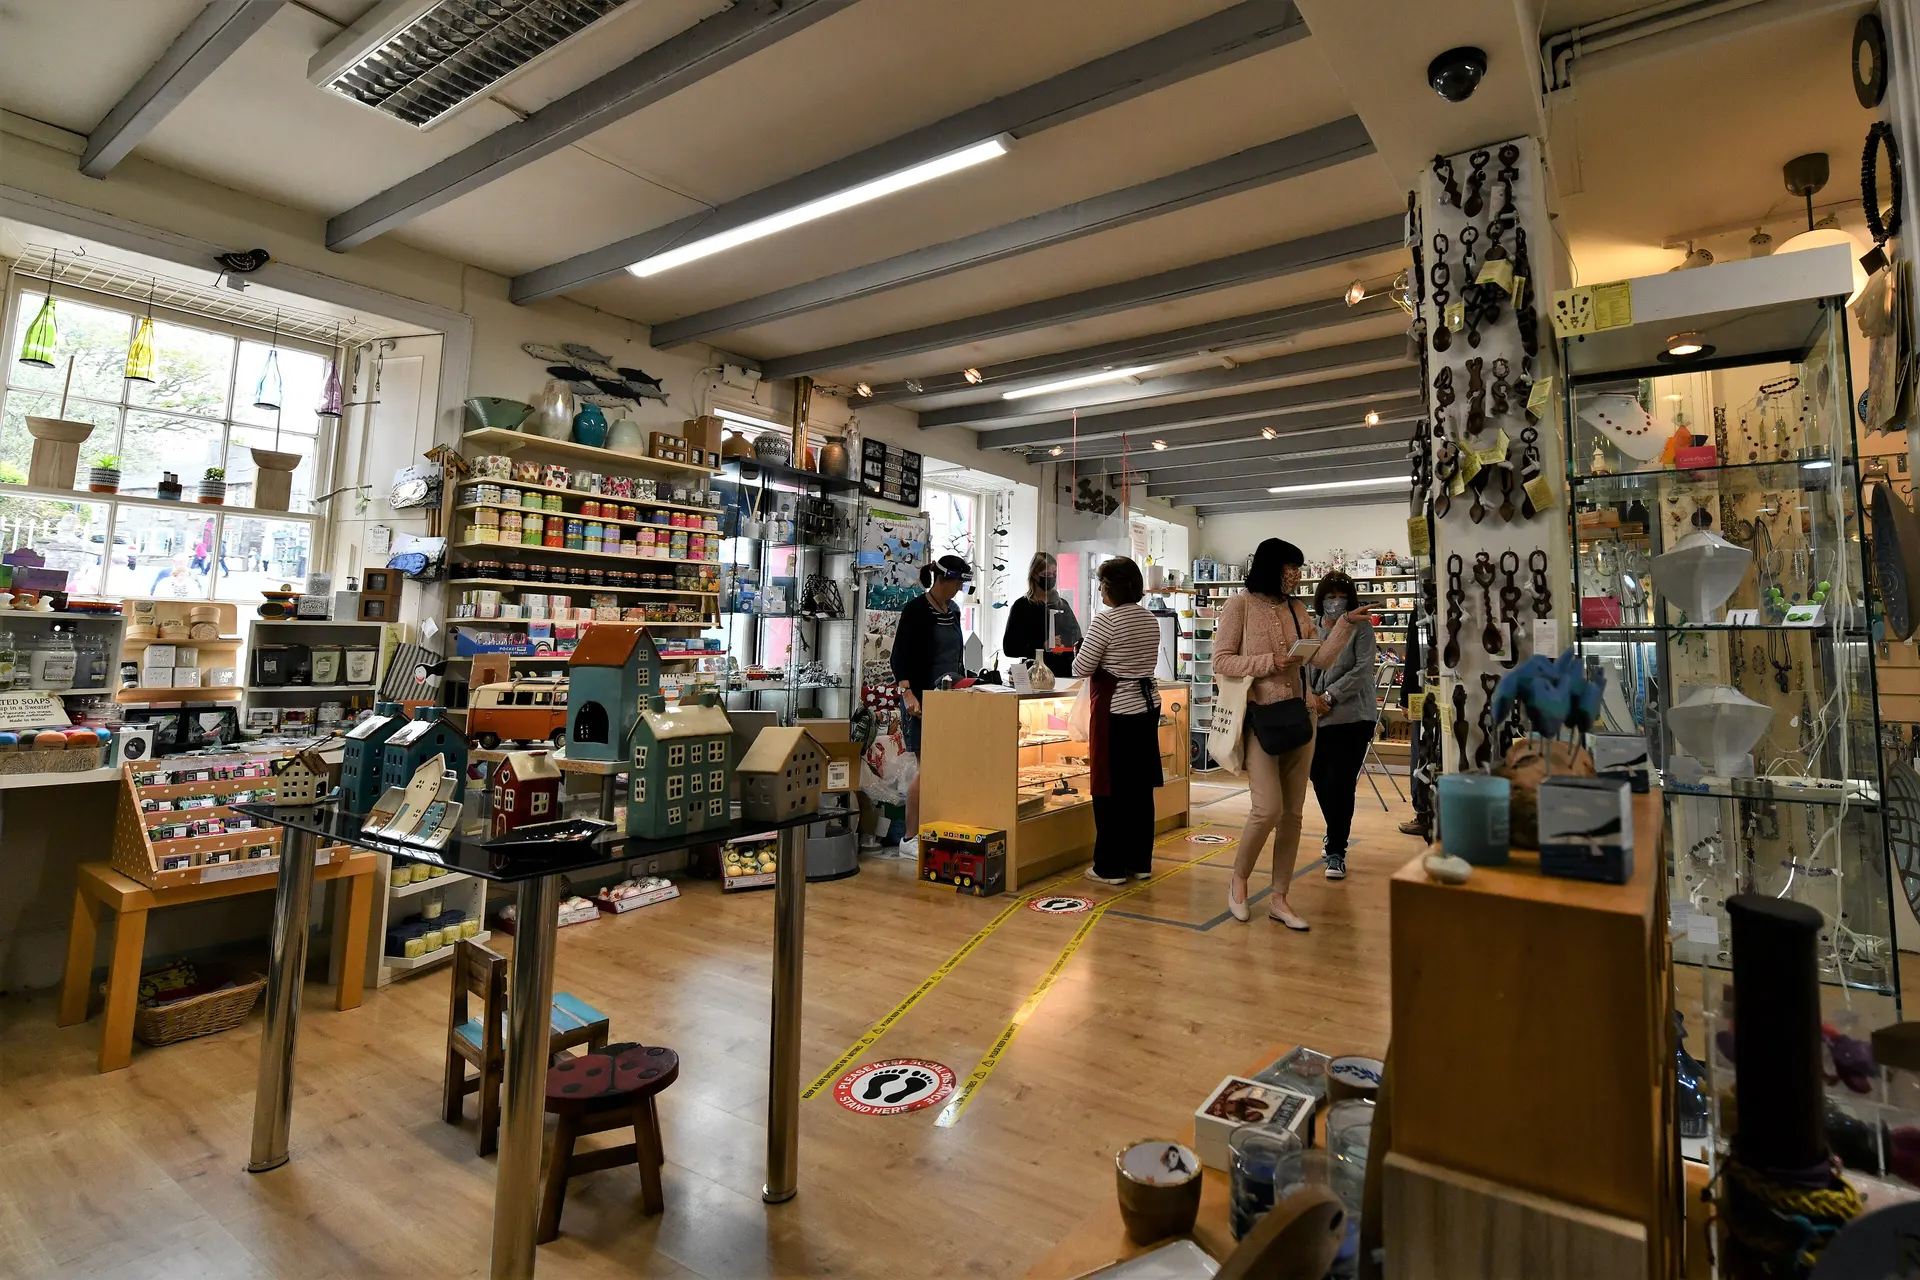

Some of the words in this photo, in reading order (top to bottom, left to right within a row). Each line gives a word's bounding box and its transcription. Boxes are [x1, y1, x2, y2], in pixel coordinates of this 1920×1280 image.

[21, 697, 51, 705] SOAPS
[873, 1060, 908, 1069] KEEP
[909, 1059, 943, 1074] SOCIAL
[838, 1065, 873, 1090] PLEASE
[923, 1072, 955, 1105] DISTANCE
[839, 1096, 872, 1113] STAND
[871, 1105, 910, 1114] HERE
